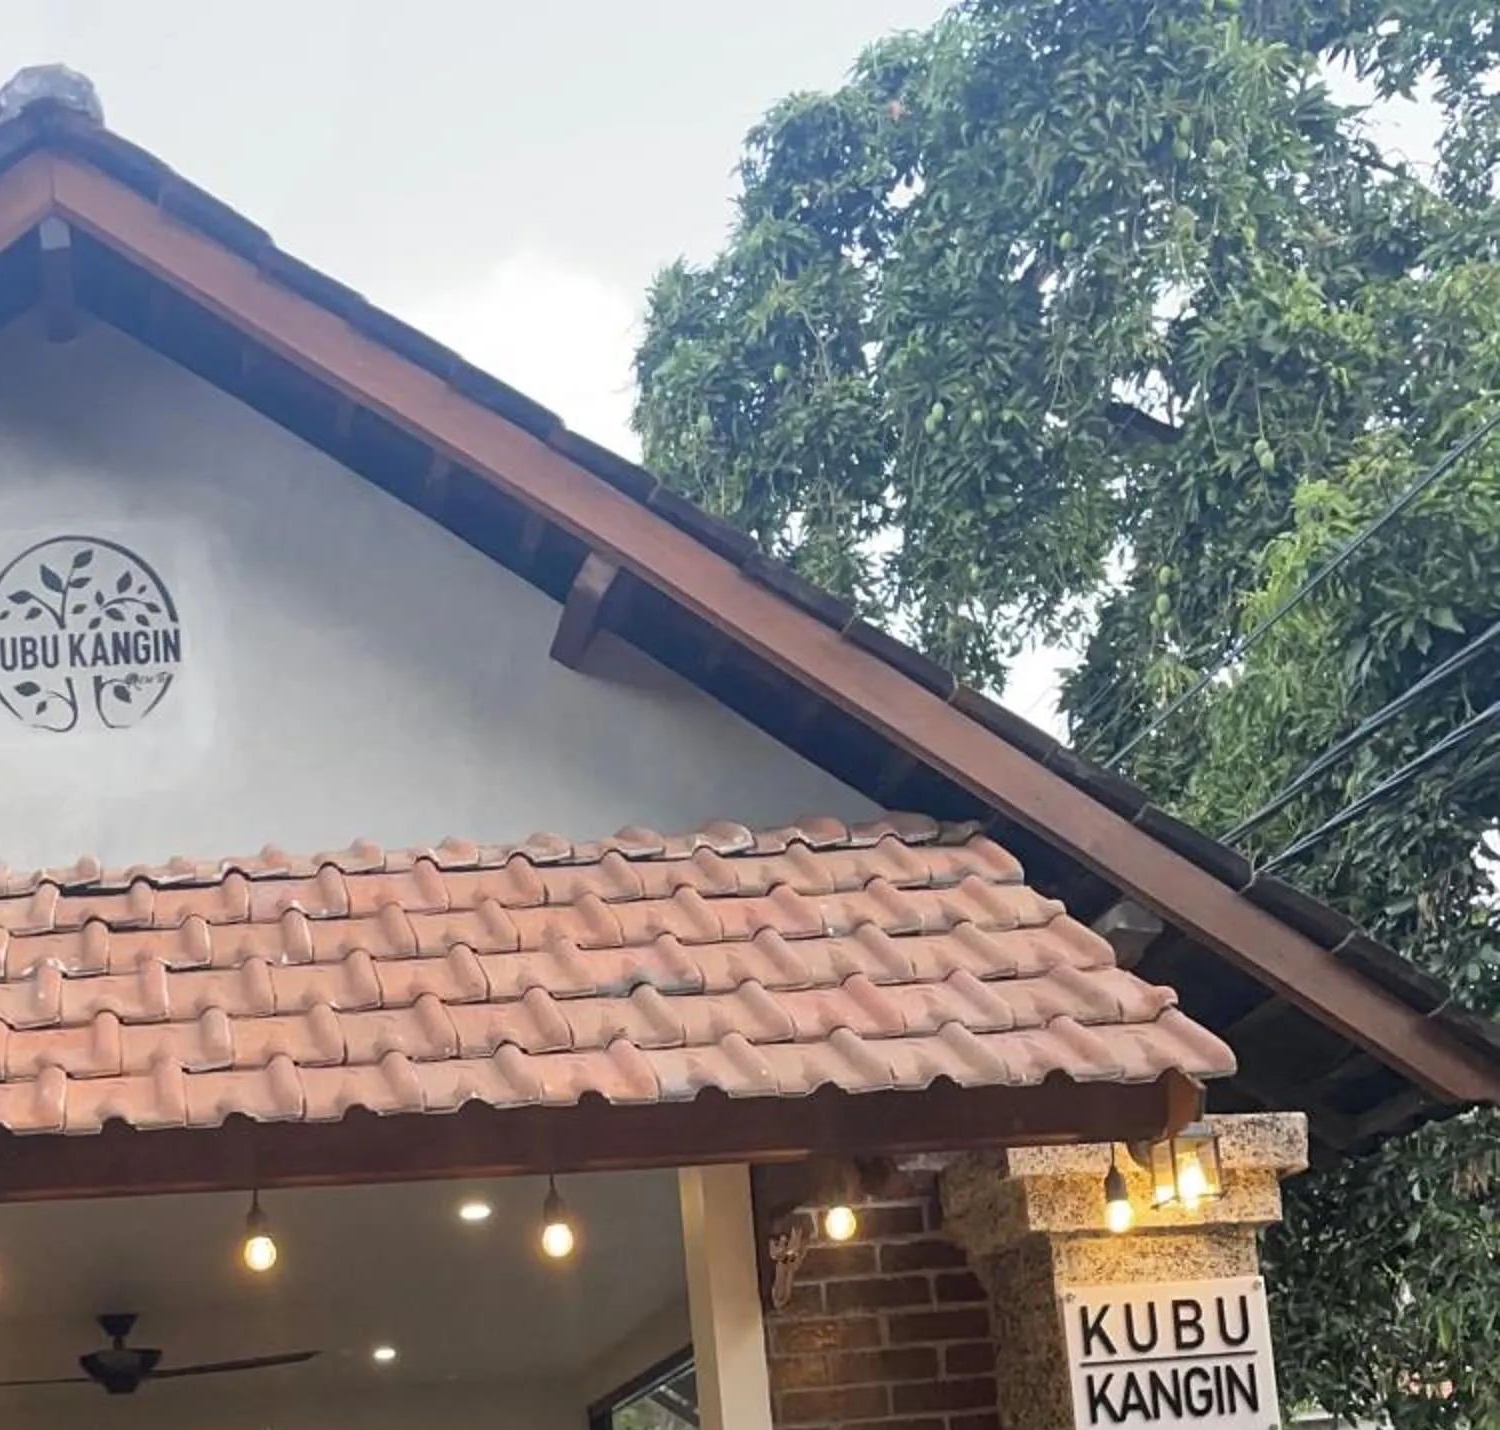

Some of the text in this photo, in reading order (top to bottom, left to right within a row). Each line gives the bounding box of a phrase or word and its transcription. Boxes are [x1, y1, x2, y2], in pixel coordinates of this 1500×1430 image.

[68, 628, 181, 668] KANGIN
[1079, 1295, 1251, 1356] KUBU
[1085, 1362, 1260, 1424] KANGIN
